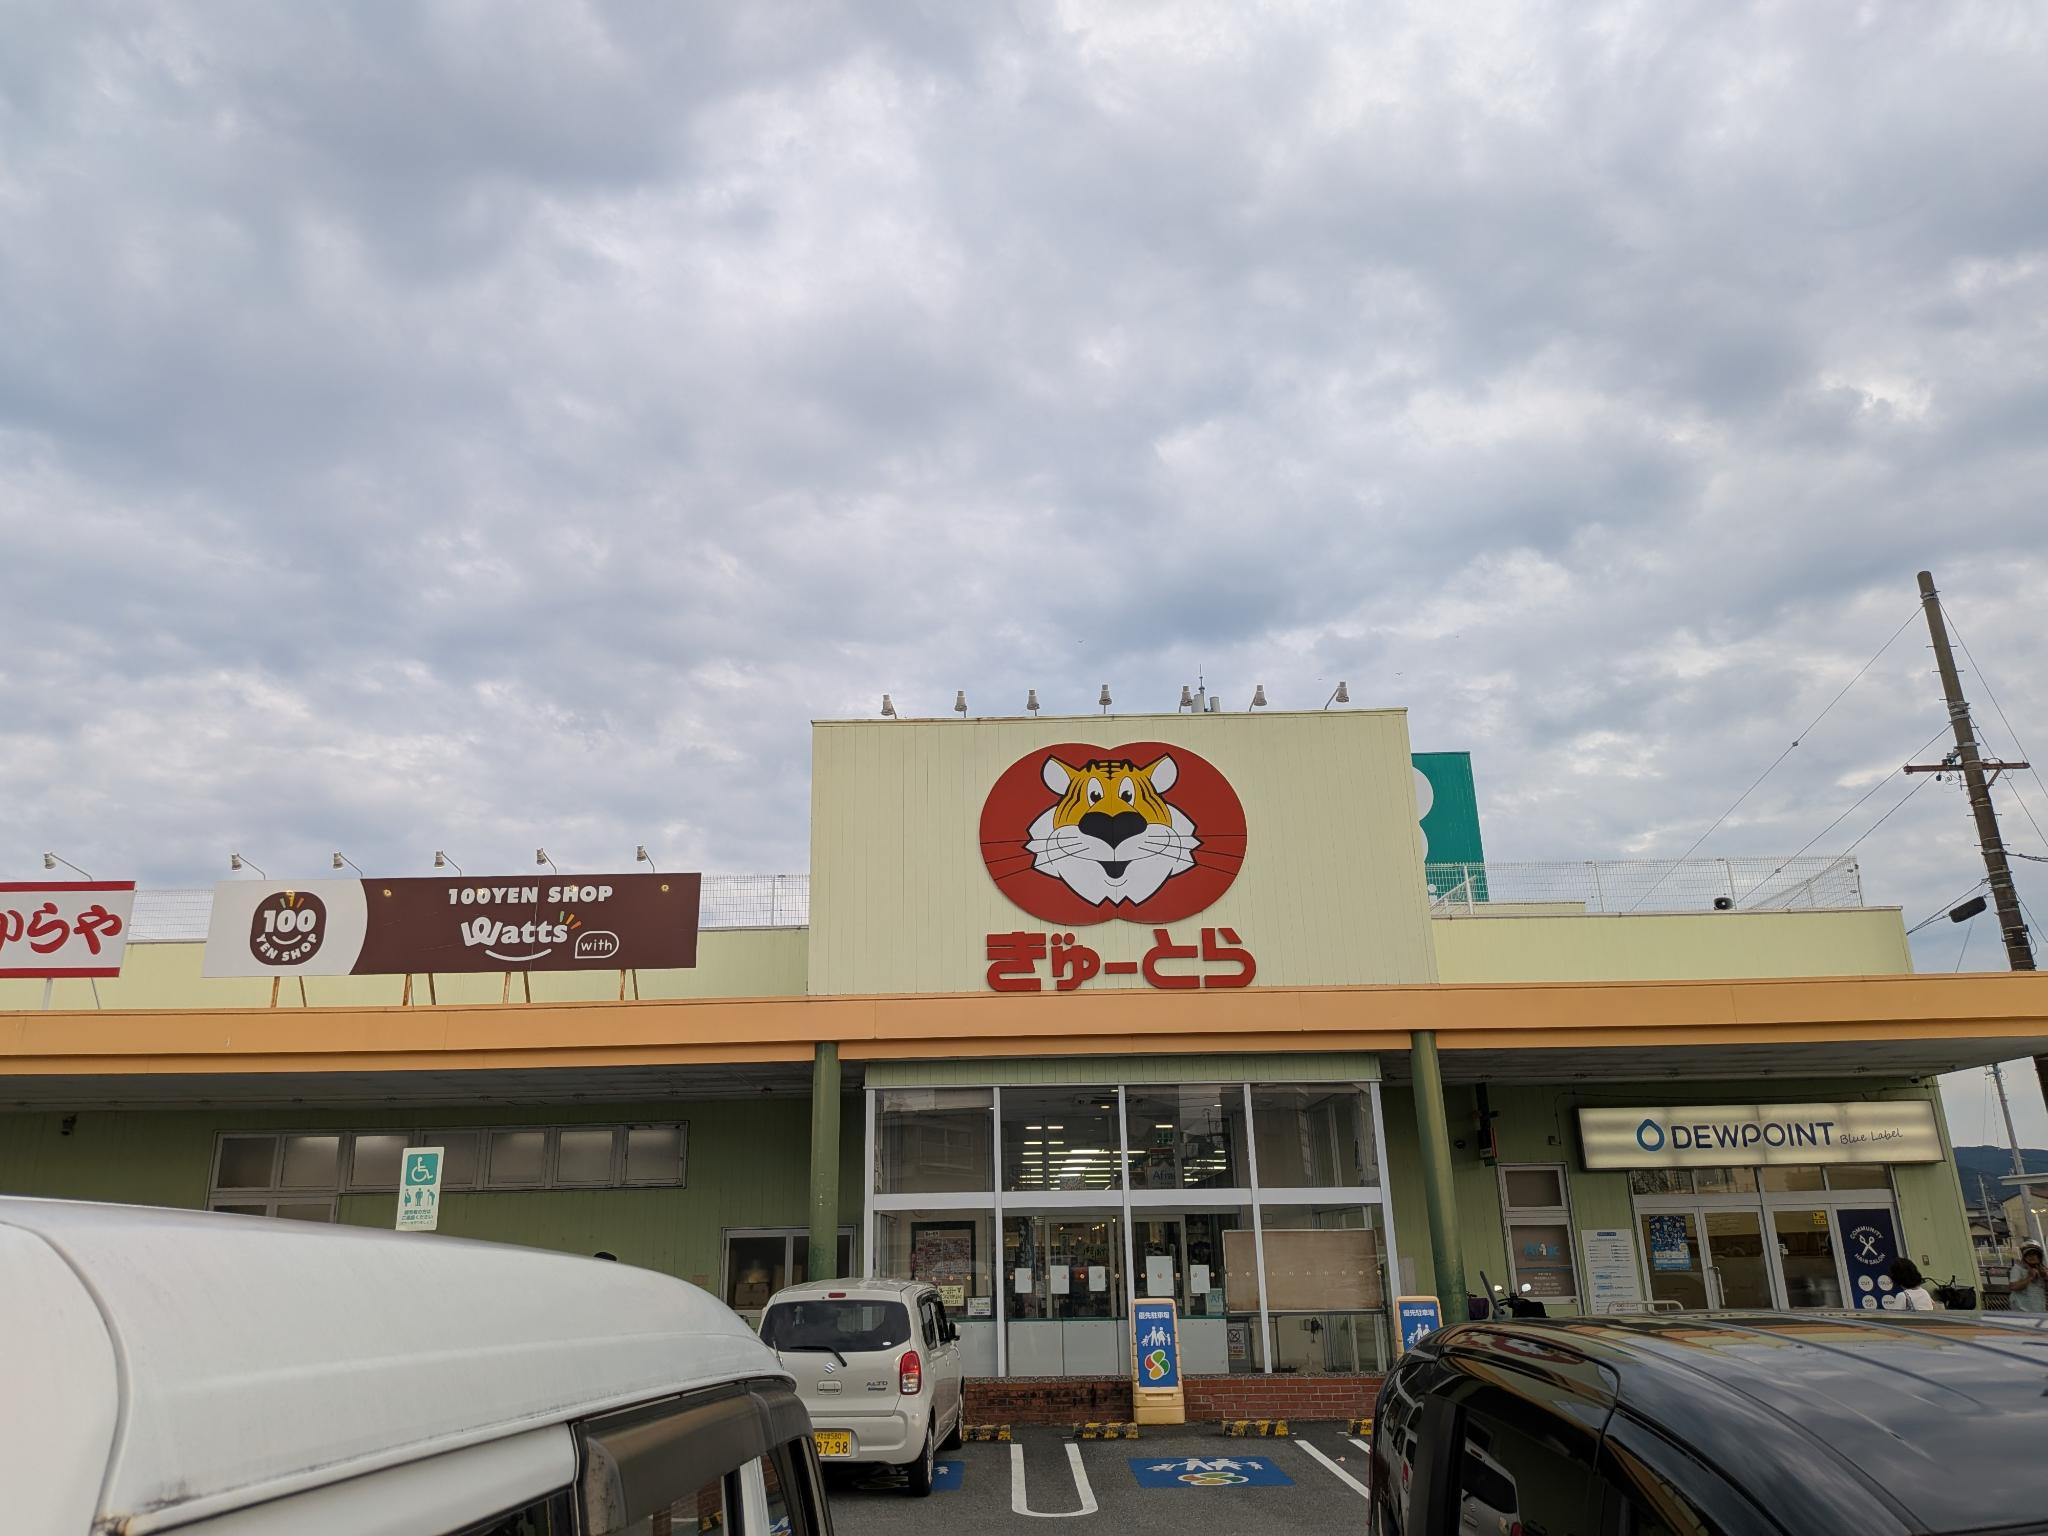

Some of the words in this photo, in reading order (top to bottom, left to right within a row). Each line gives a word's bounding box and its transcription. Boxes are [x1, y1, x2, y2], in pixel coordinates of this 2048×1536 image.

[449, 886, 539, 905] 100YEN
[548, 885, 613, 904] SHOP
[264, 908, 317, 933] 100
[460, 916, 568, 947] Watts
[256, 933, 279, 960] YEN
[281, 933, 317, 962] SHOP
[581, 938, 613, 952] with
[1671, 1121, 1835, 1150] DEWPOINT
[1840, 1133, 1868, 1145] Blue
[1871, 1127, 1904, 1142] Label
[1850, 1226, 1883, 1239] COMMUNITY
